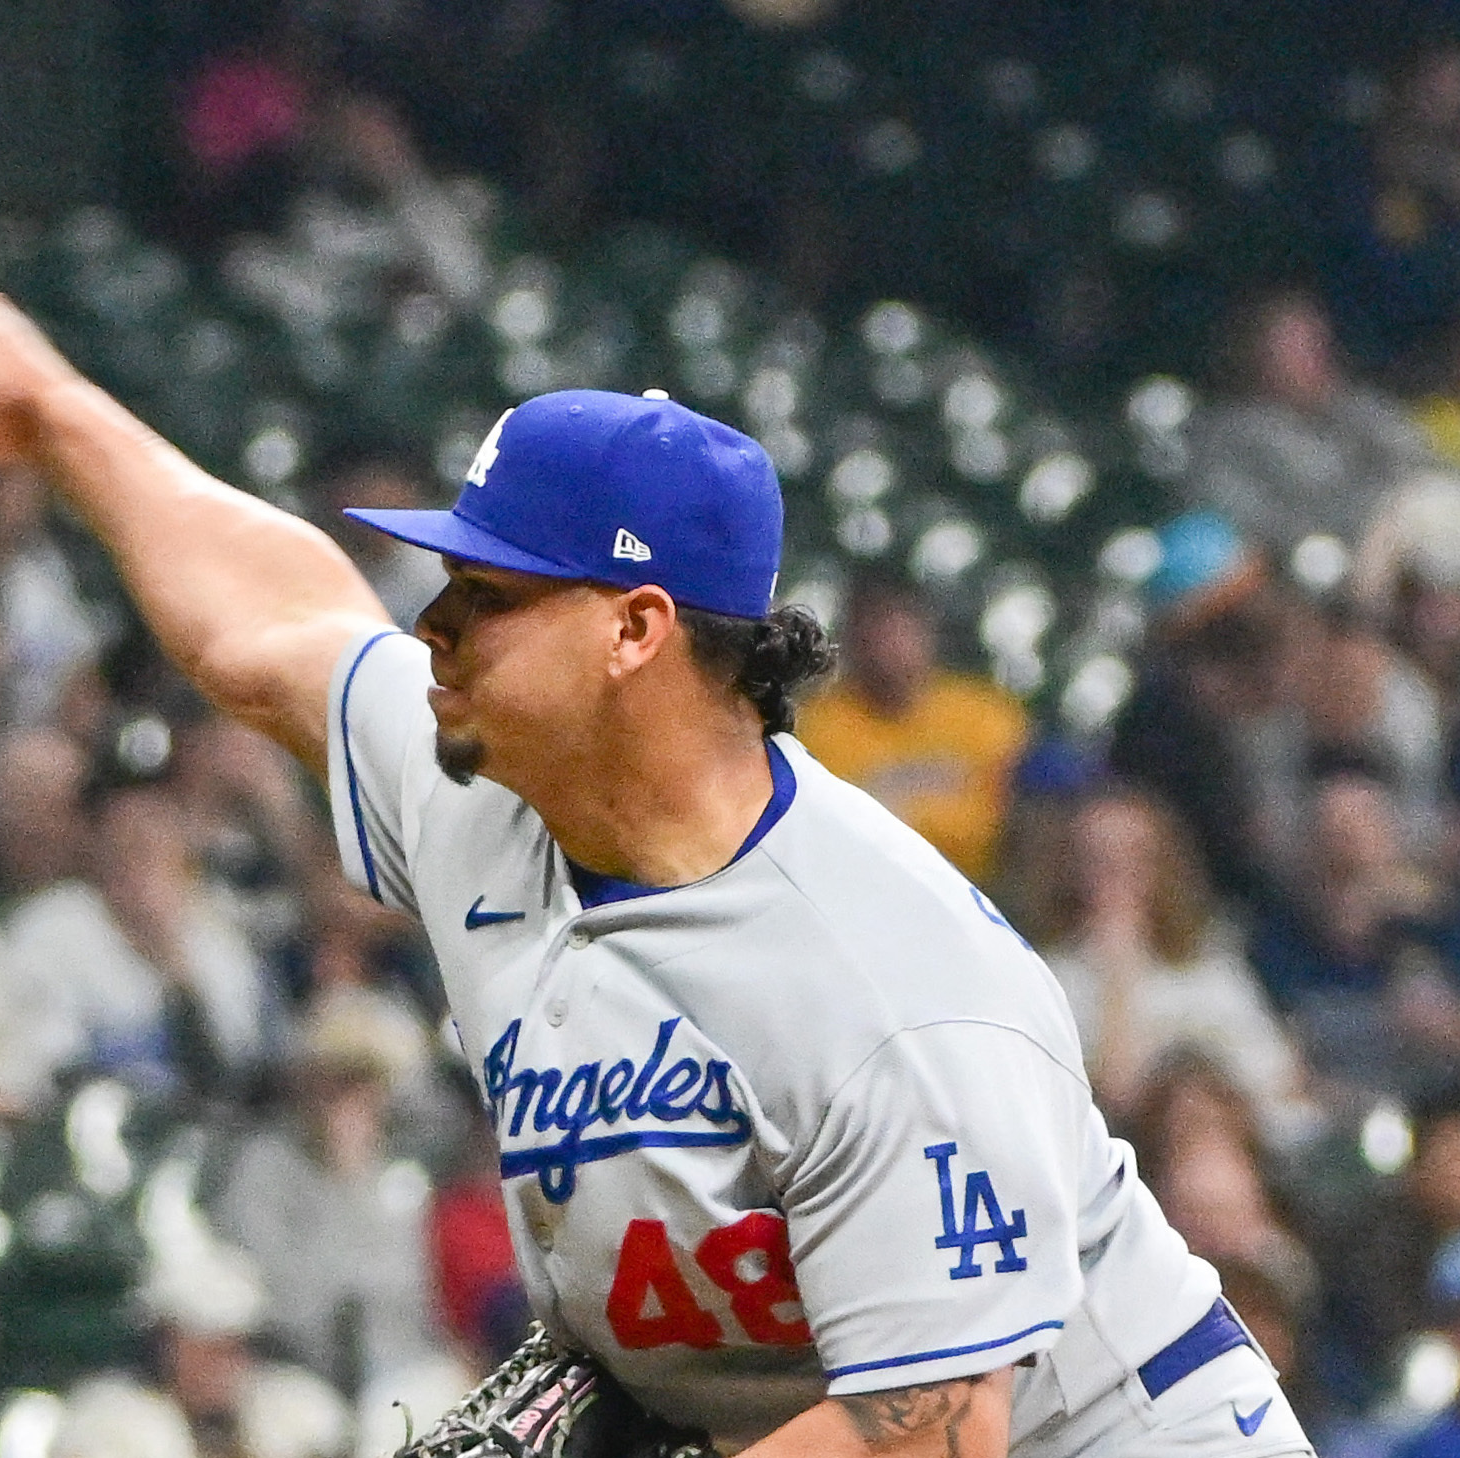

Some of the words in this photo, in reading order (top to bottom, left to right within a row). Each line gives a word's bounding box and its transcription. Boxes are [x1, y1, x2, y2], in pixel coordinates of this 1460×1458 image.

[484, 1015, 752, 1204] Angeles
[605, 1209, 814, 1352] 48
[924, 1140, 1028, 1281] LA
